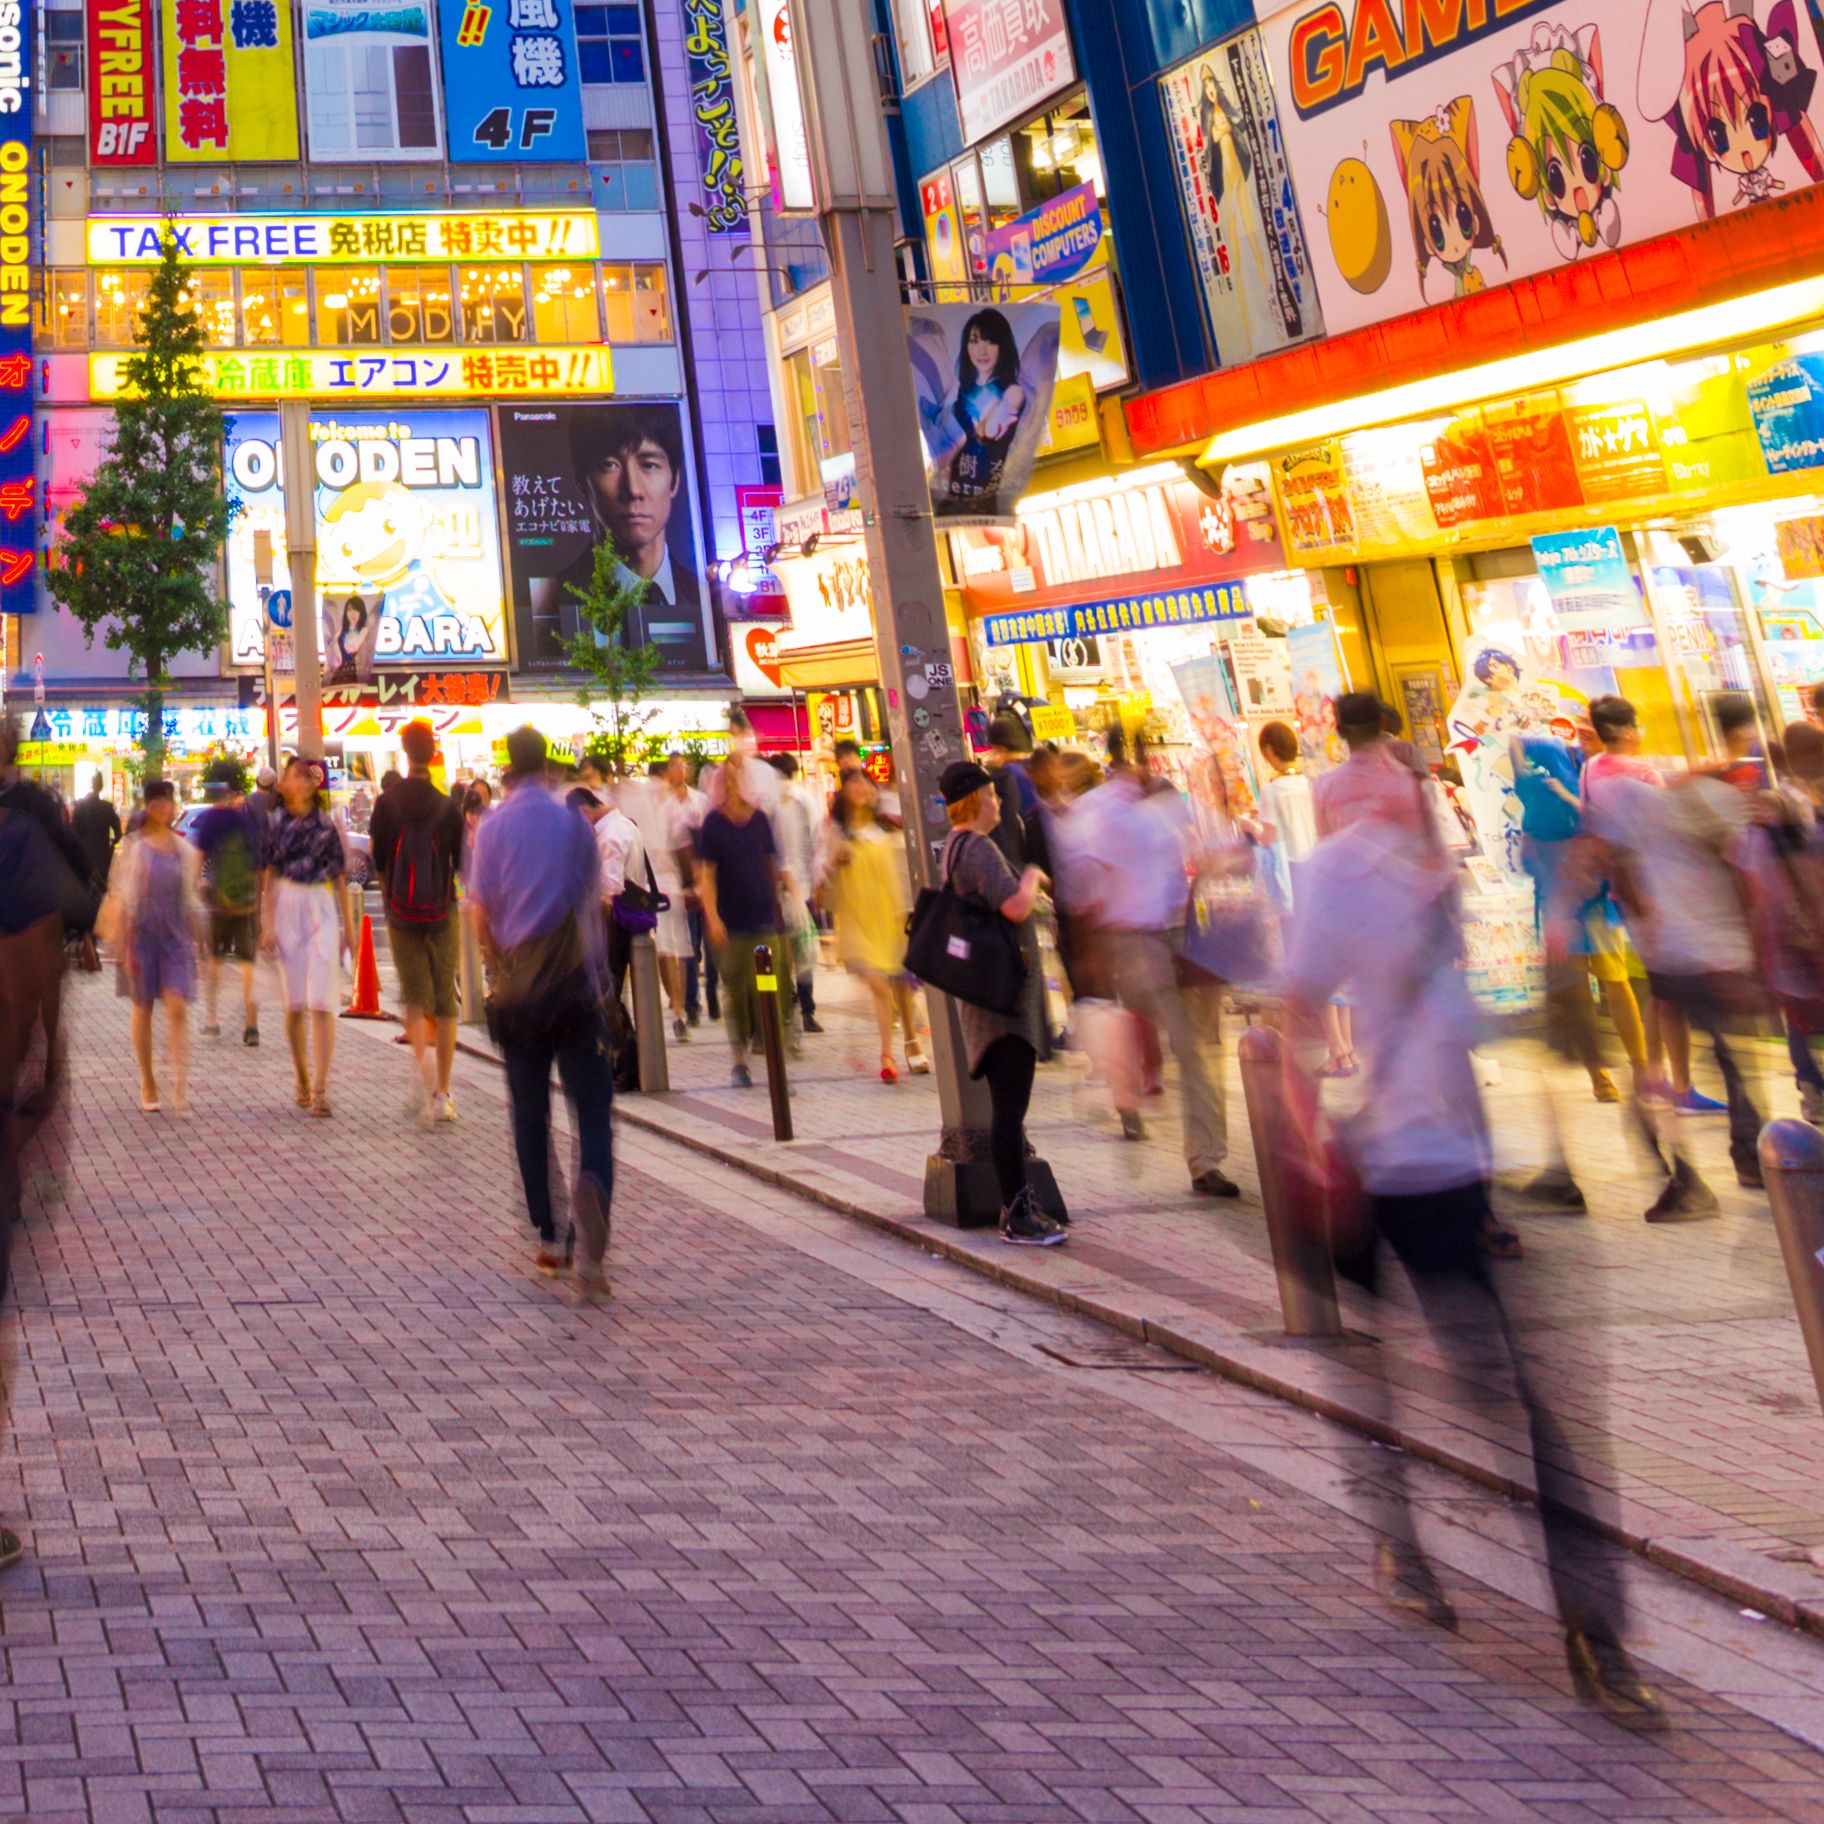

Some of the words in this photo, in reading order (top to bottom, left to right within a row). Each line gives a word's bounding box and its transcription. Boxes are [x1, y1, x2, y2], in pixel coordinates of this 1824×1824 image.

[97, 121, 149, 157] B1F
[473, 108, 556, 150] 4F
[924, 183, 953, 215] 2F
[0, 139, 31, 326] ONODEN
[1031, 192, 1088, 241] DISCOUNT
[110, 225, 192, 258] TAX
[209, 224, 319, 256] FREE
[329, 220, 428, 257] 免税店
[1031, 218, 1099, 270] COMPUTERS
[348, 304, 528, 342] MODIFY
[217, 358, 314, 390] 冷蔵庫
[328, 359, 451, 388] エアコン
[384, 421, 413, 441] to
[513, 411, 557, 422] Panasonic
[232, 438, 480, 490] OODEN
[511, 474, 563, 497] 教えて
[513, 498, 585, 520] あげたい
[749, 508, 768, 523] 4F
[752, 526, 770, 540] 3F
[926, 675, 954, 688] ONE
[928, 664, 949, 677] JS
